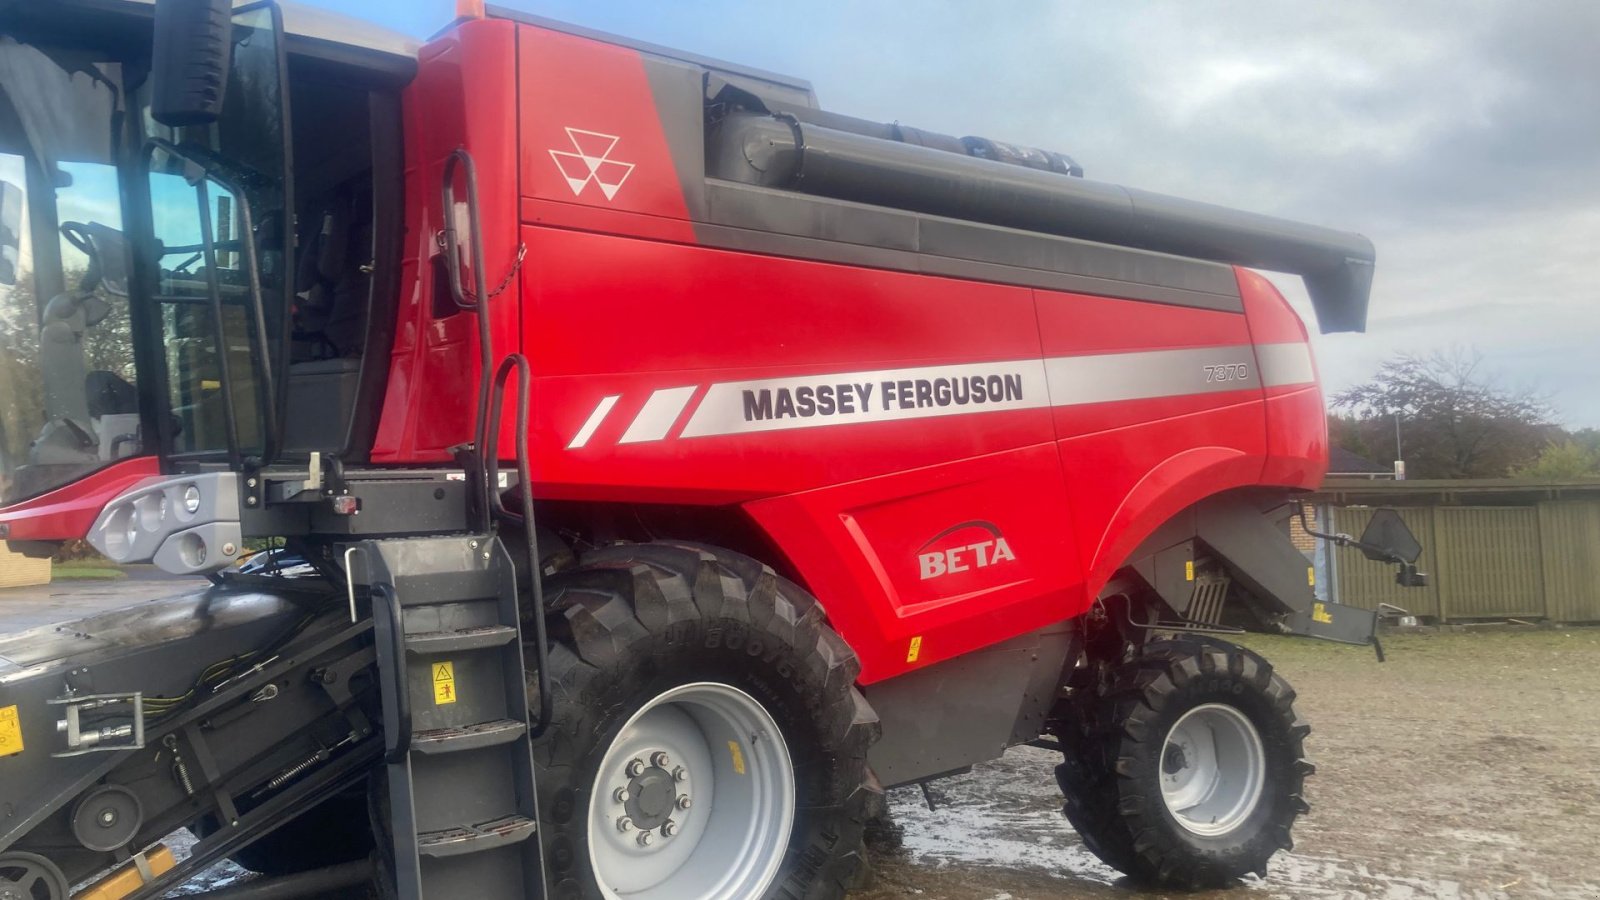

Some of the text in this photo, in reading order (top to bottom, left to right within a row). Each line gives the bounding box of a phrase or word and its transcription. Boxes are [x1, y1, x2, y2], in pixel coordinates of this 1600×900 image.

[1203, 363, 1248, 383] 7370
[742, 374, 1023, 421] MASSEY FERGUSON
[918, 537, 1016, 580] BETA
